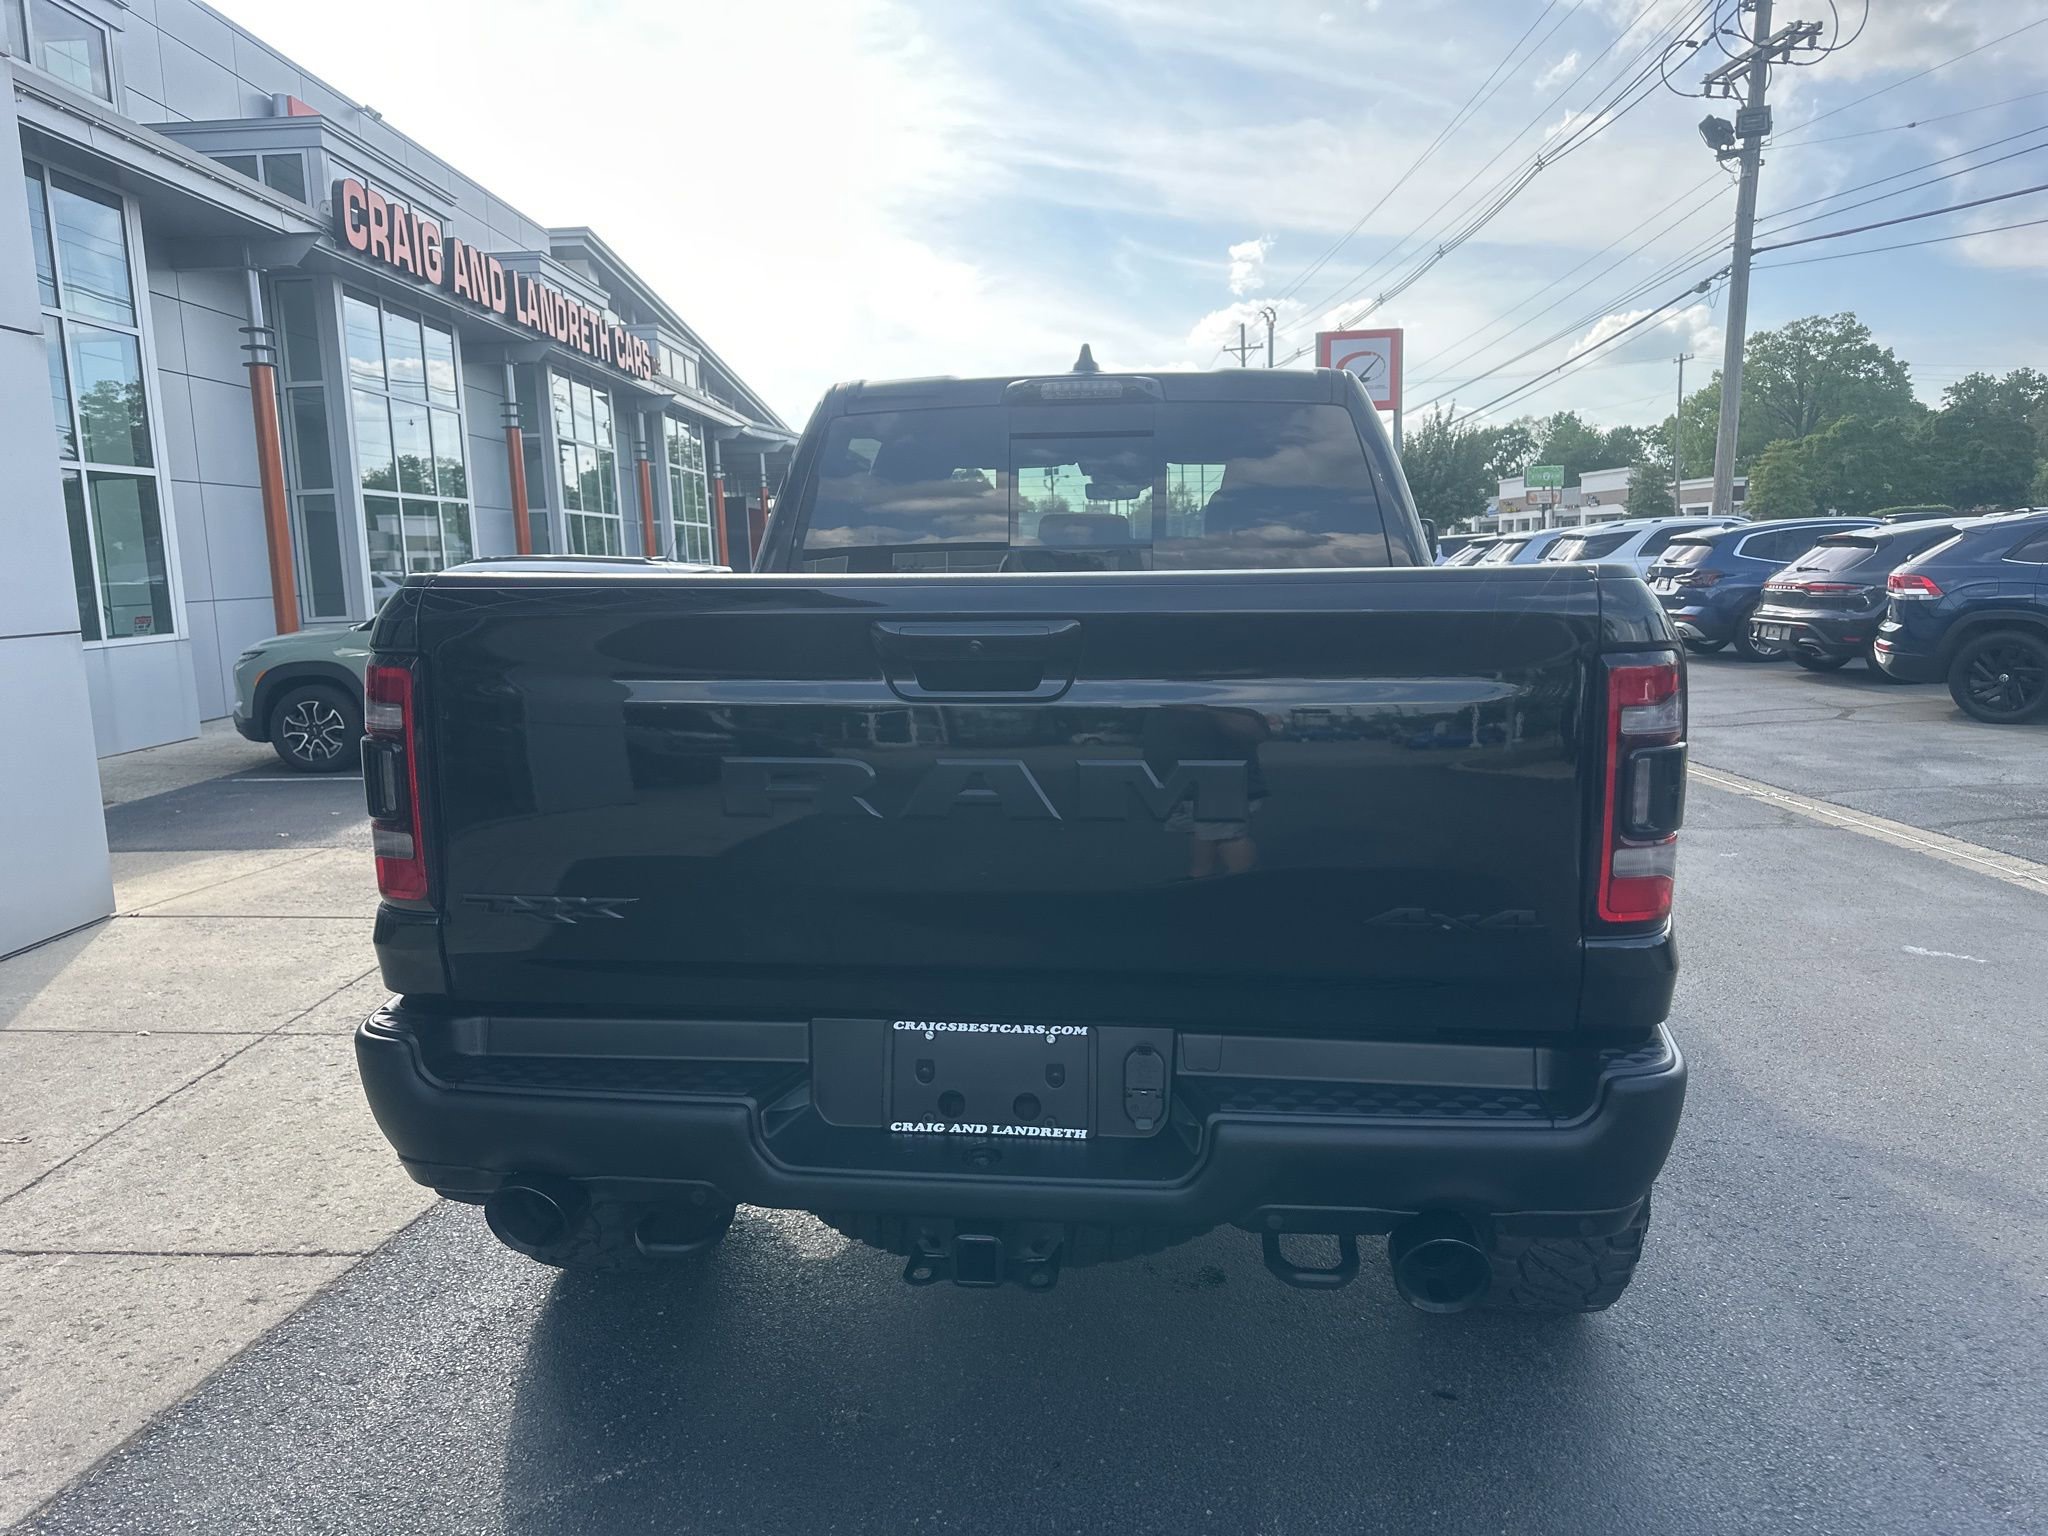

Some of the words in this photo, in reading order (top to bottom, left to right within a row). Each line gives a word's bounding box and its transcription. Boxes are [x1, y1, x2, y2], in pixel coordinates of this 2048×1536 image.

[341, 177, 444, 286] CRAIG
[454, 237, 507, 315] AND
[512, 270, 612, 364] LANDRETH
[615, 326, 652, 381] CARS
[720, 756, 1249, 823] RAM
[893, 1020, 1089, 1036] CRAIGSBESTCARS.COM
[890, 1121, 945, 1133] CRAIG
[949, 1123, 988, 1134] AND
[991, 1124, 1088, 1139] LANDRETH
